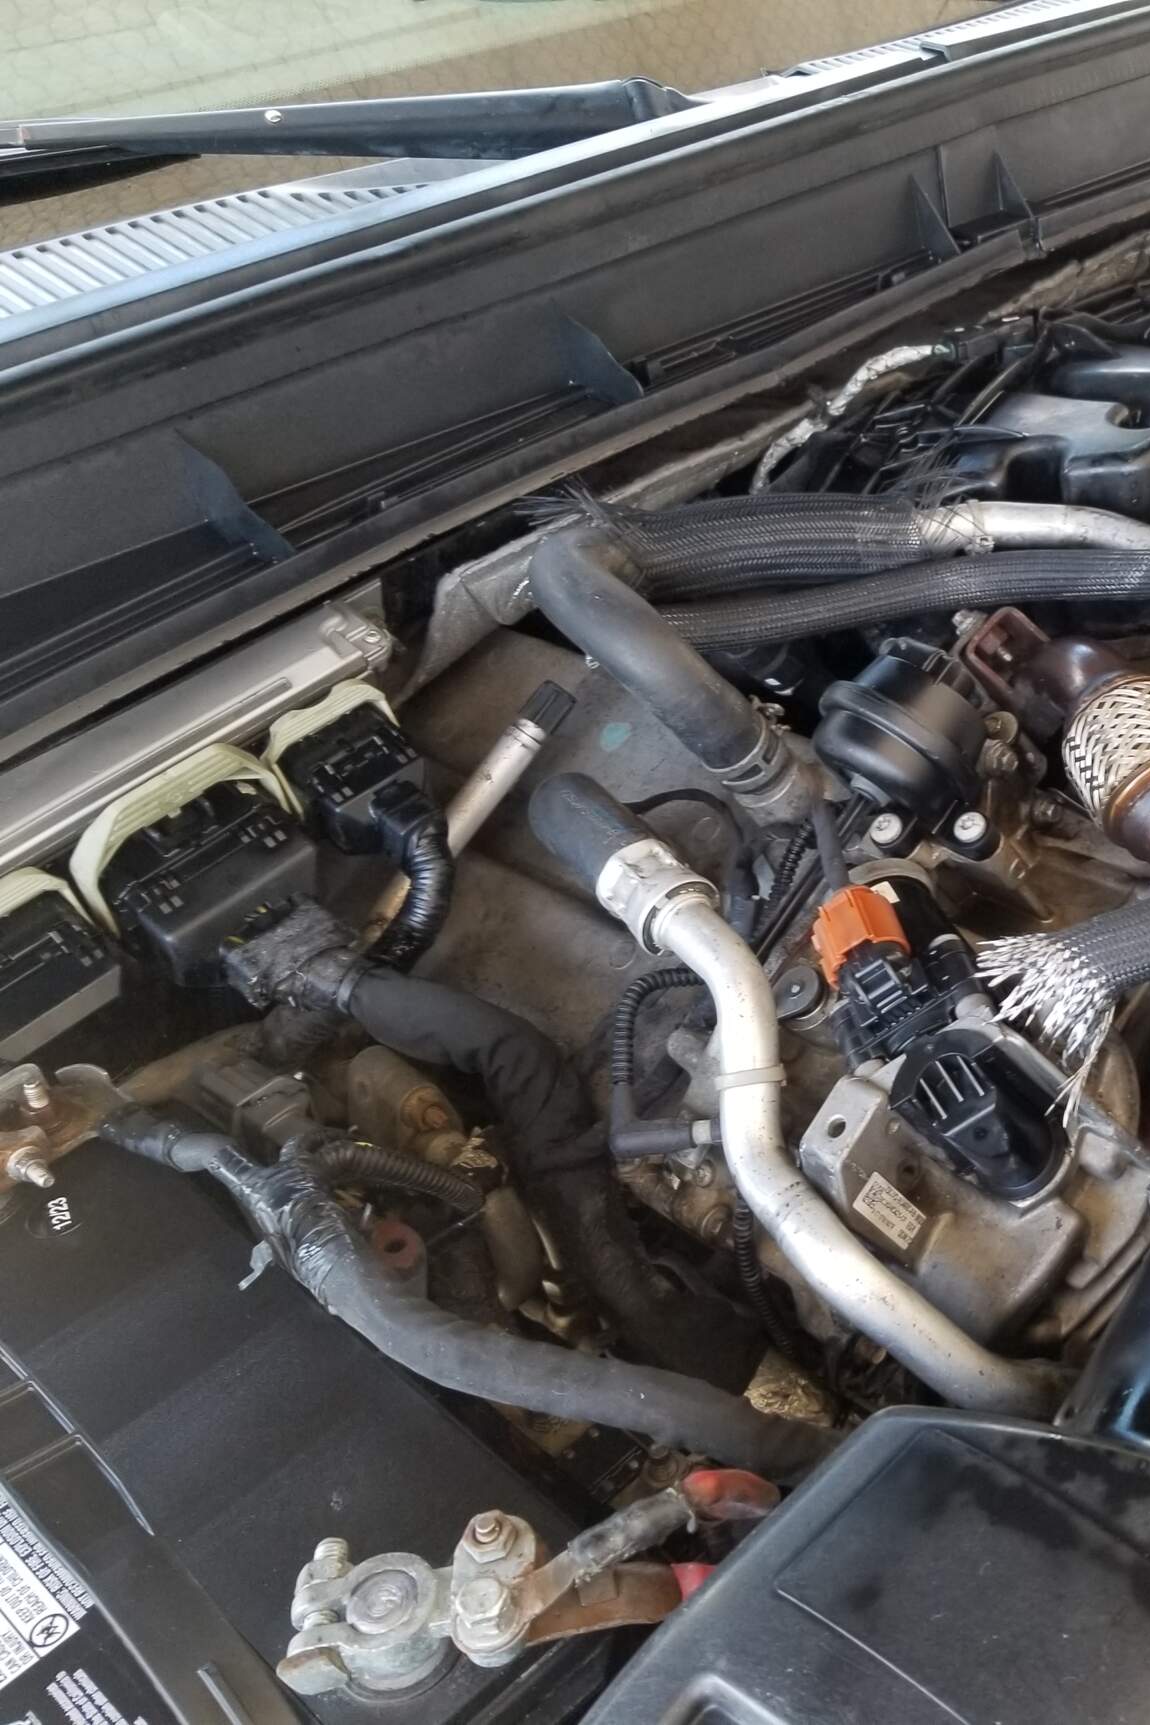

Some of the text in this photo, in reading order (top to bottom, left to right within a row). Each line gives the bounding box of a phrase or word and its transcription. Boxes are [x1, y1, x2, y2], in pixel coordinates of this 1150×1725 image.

[47, 1196, 72, 1231] 12/23
[16, 1583, 31, 1595] OF
[4, 1592, 23, 1609] OUT
[23, 1590, 48, 1614] REACH
[14, 1606, 36, 1624] KEEP
[0, 1630, 25, 1655] INJURY
[18, 1650, 34, 1665] OR
